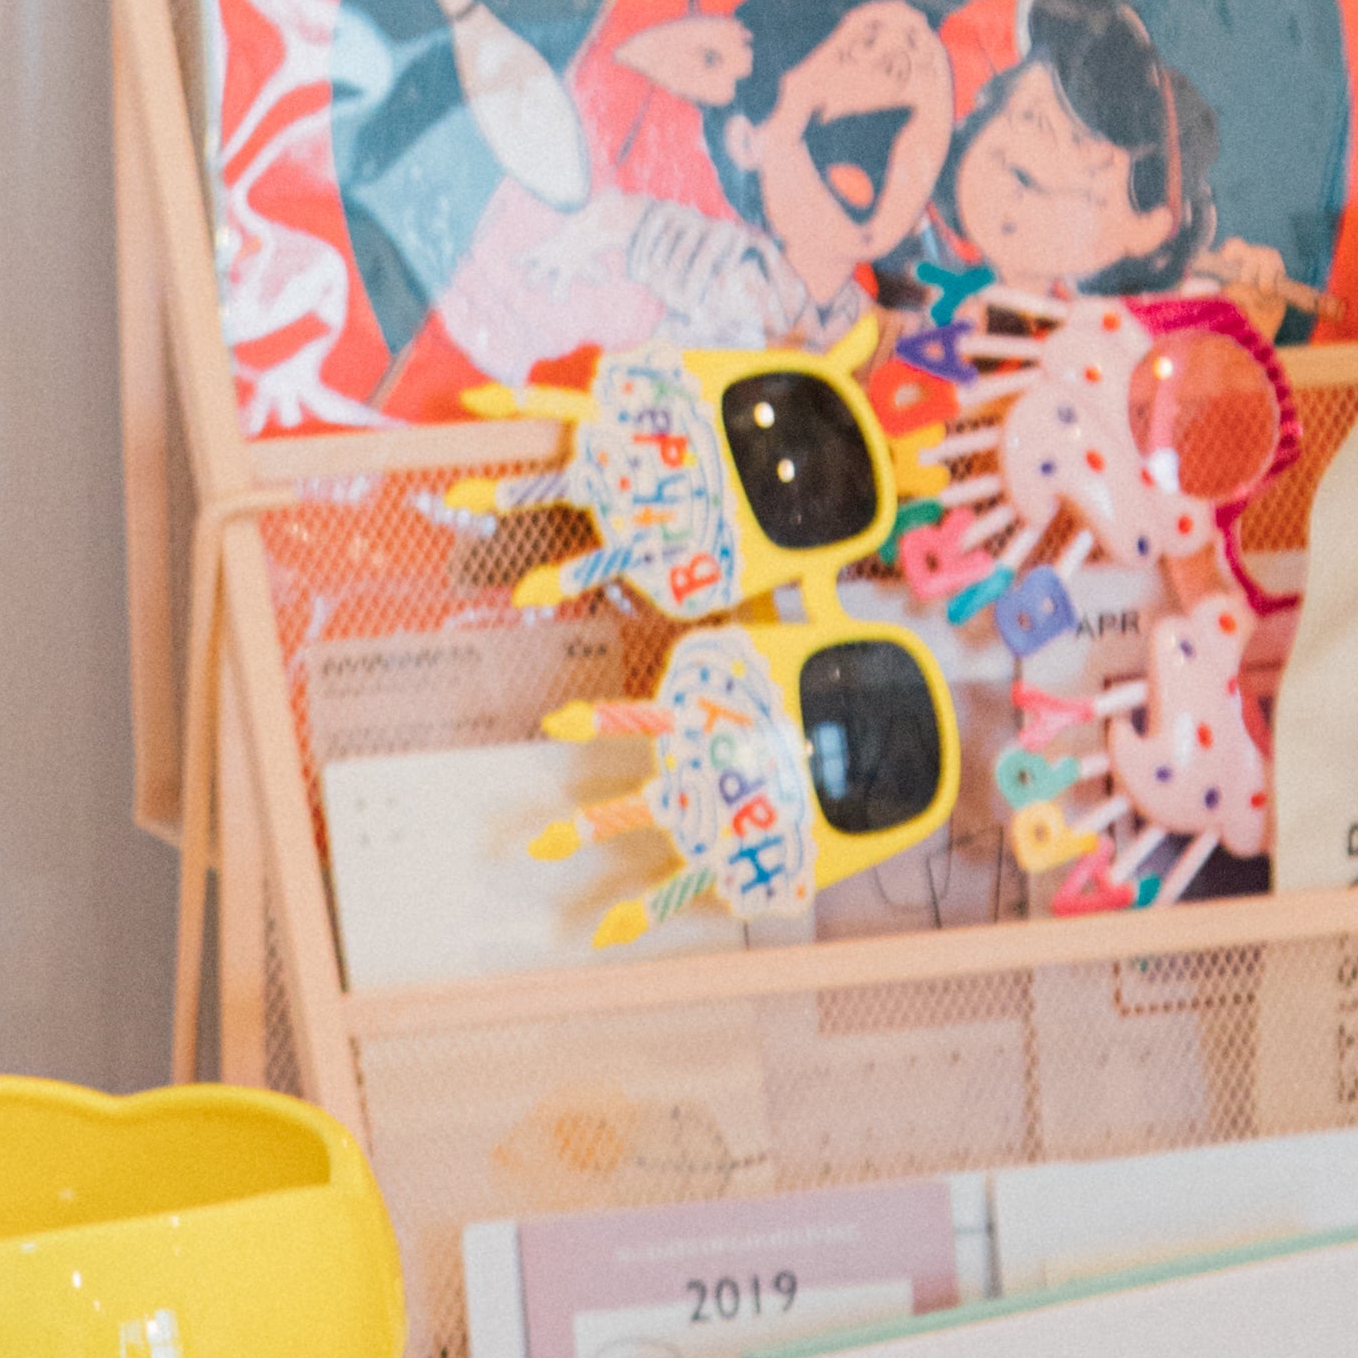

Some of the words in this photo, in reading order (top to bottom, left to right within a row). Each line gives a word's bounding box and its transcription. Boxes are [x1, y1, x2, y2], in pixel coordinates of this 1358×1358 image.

[1073, 609, 1141, 639] APR
[997, 678, 1163, 917] APPY
[685, 1271, 800, 1324] 2019
